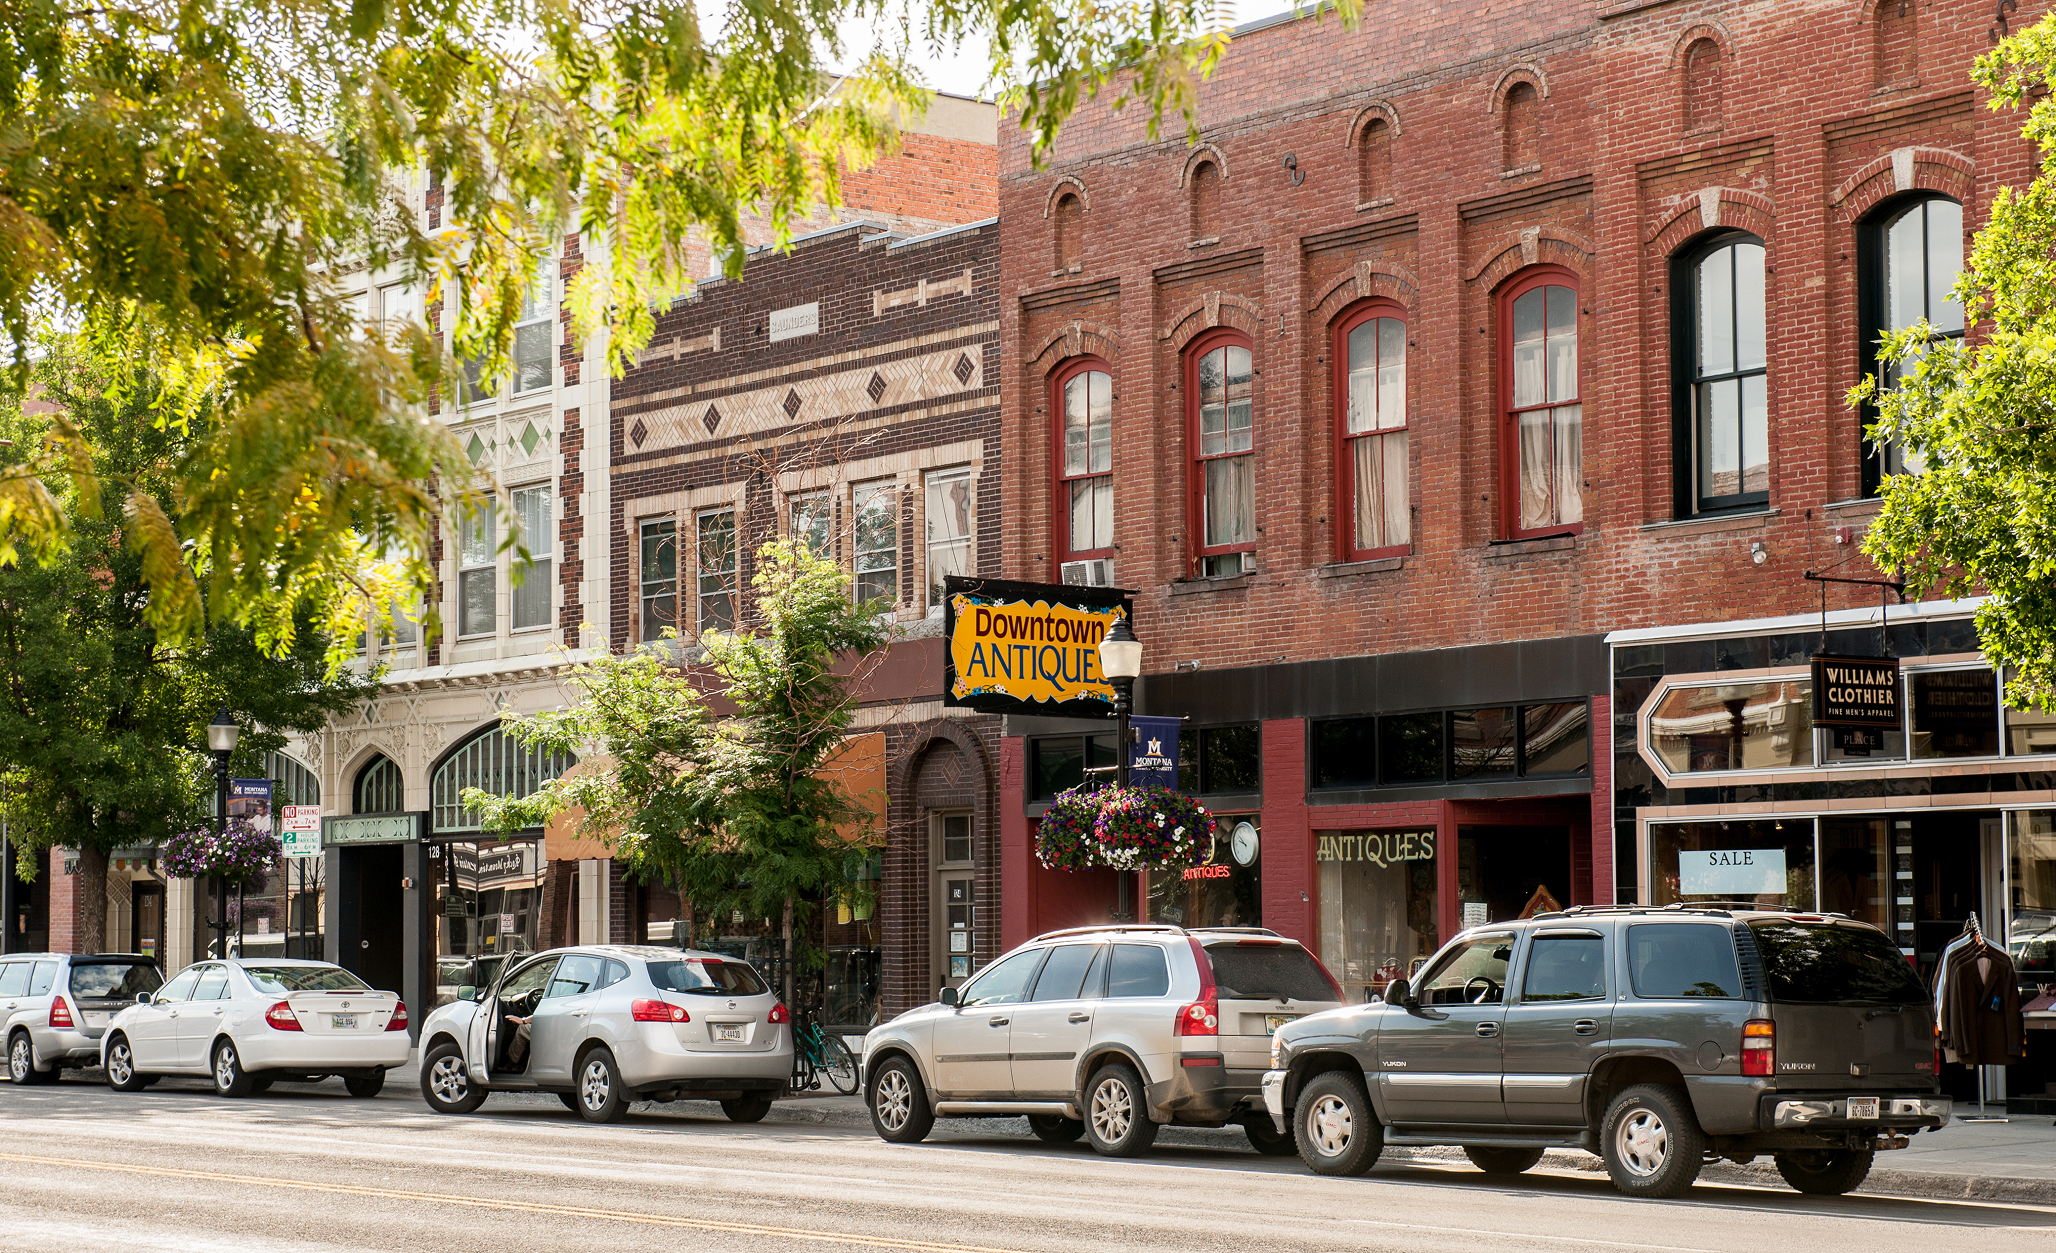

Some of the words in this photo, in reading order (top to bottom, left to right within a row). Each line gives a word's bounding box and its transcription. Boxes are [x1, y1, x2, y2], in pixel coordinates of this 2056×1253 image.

[771, 312, 817, 334] SAUNDERS
[976, 608, 1105, 645] Downtown
[966, 642, 1111, 692] ANTIQUE
[1826, 667, 1894, 686] WILLIAMS
[1828, 687, 1894, 705] CLOTHIER
[1828, 707, 1843, 715] FINE
[1845, 708, 1865, 716] MEN'S
[1867, 709, 1894, 717] APPAREL
[1843, 731, 1876, 746] PLACE
[1135, 757, 1173, 767] MONTANA
[285, 807, 296, 818] NO
[298, 808, 319, 816] PARKING
[286, 833, 294, 843] 2
[428, 845, 440, 859] 128
[1317, 831, 1435, 869] ANTIQUES
[1709, 851, 1754, 866] SALE
[1183, 865, 1230, 881] ANTIQUES
[1779, 1062, 1816, 1070] YUKON
[1914, 1062, 1932, 1070] GMC
[1325, 1121, 1338, 1129] GMC
[1636, 1138, 1650, 1147] GMC
